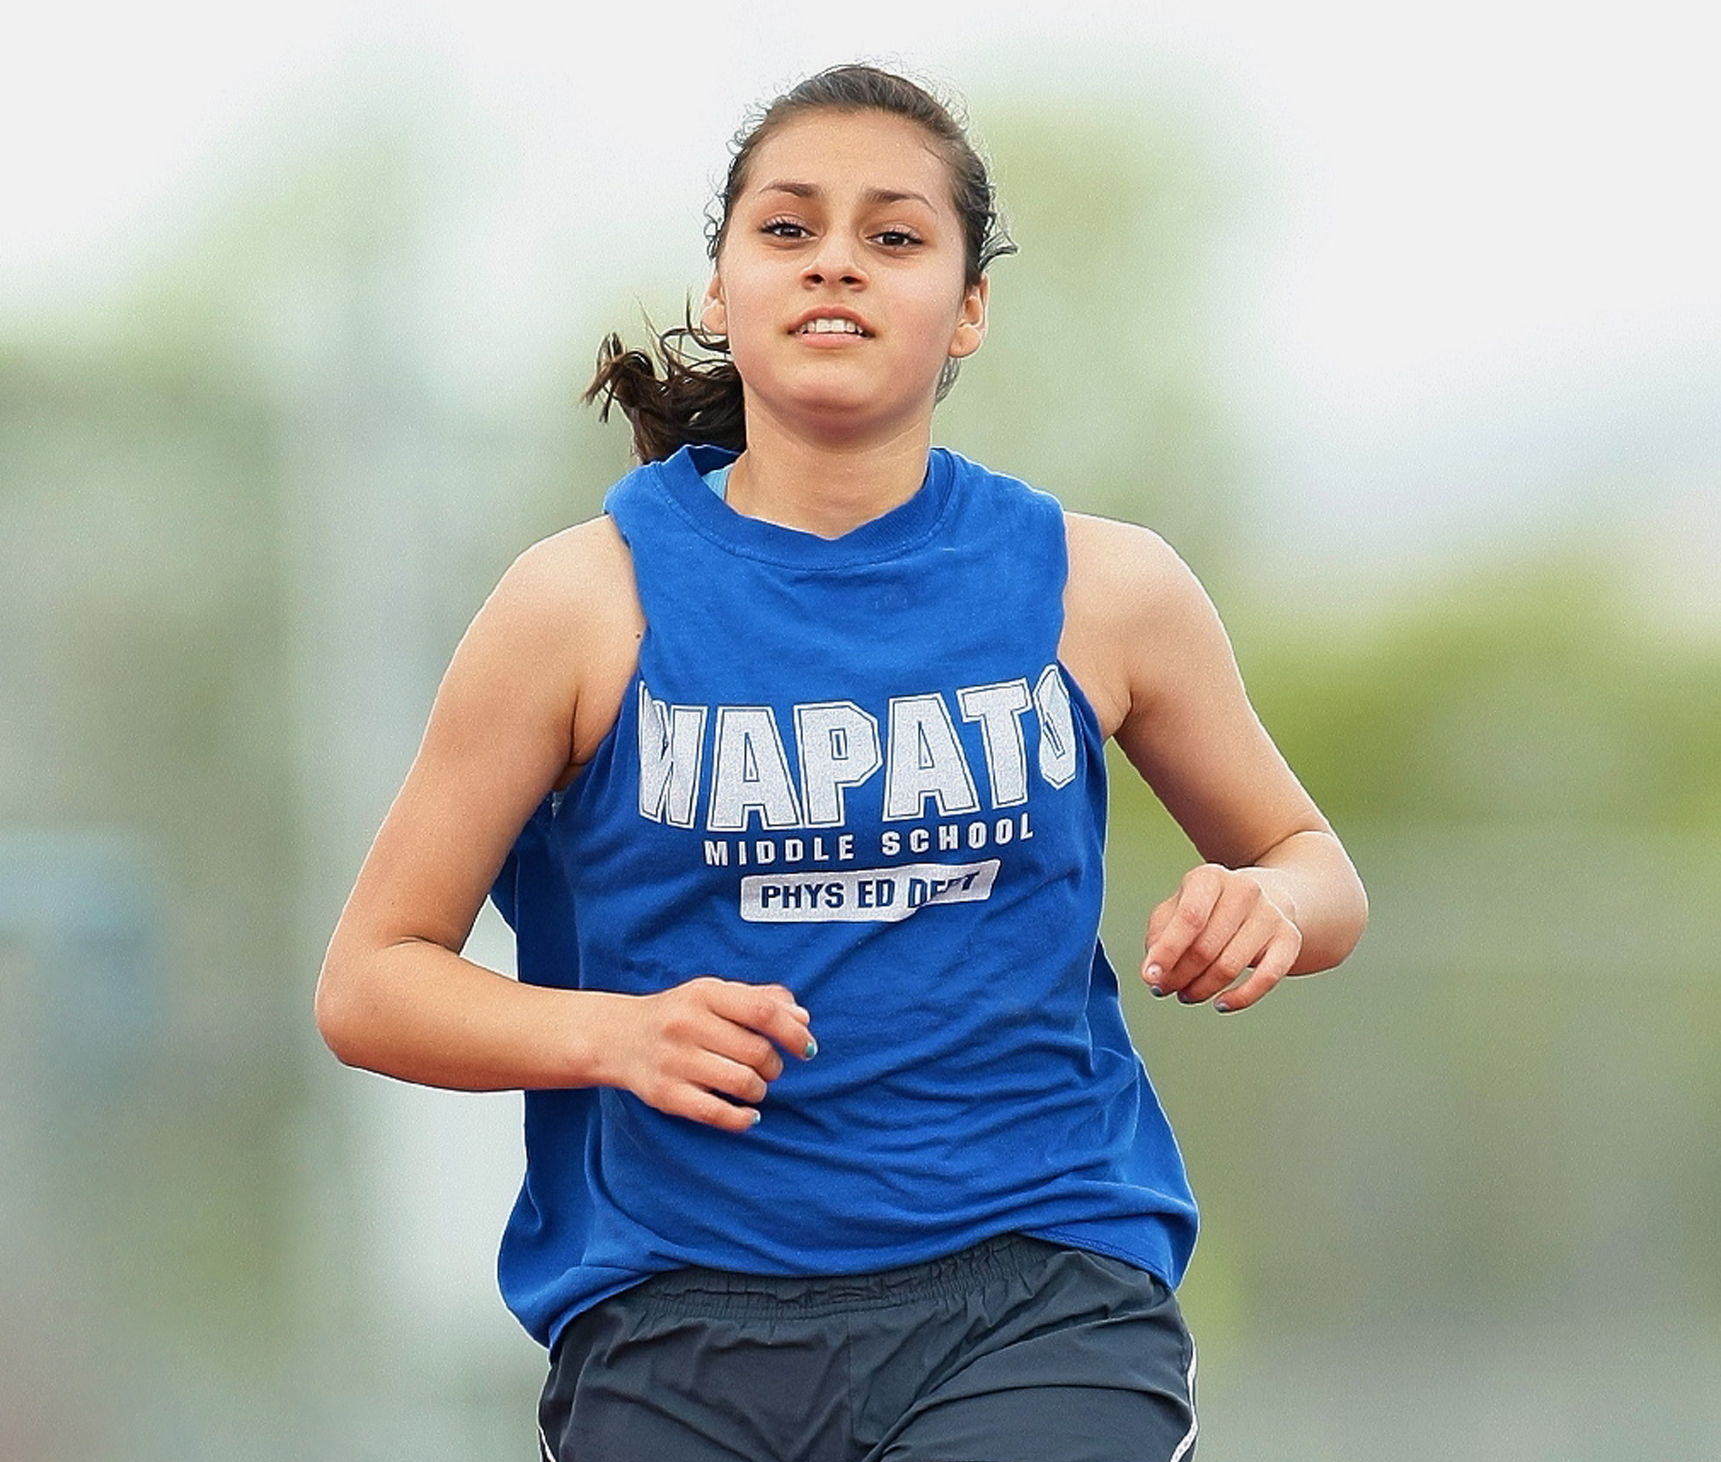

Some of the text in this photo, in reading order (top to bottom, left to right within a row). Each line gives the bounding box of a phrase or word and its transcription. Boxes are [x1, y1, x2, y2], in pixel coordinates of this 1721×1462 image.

[638, 664, 1077, 832] WAPATO
[704, 813, 1034, 866] MIDDLE SCHOOL
[760, 882, 844, 908] PHYS
[857, 879, 896, 908] ED
